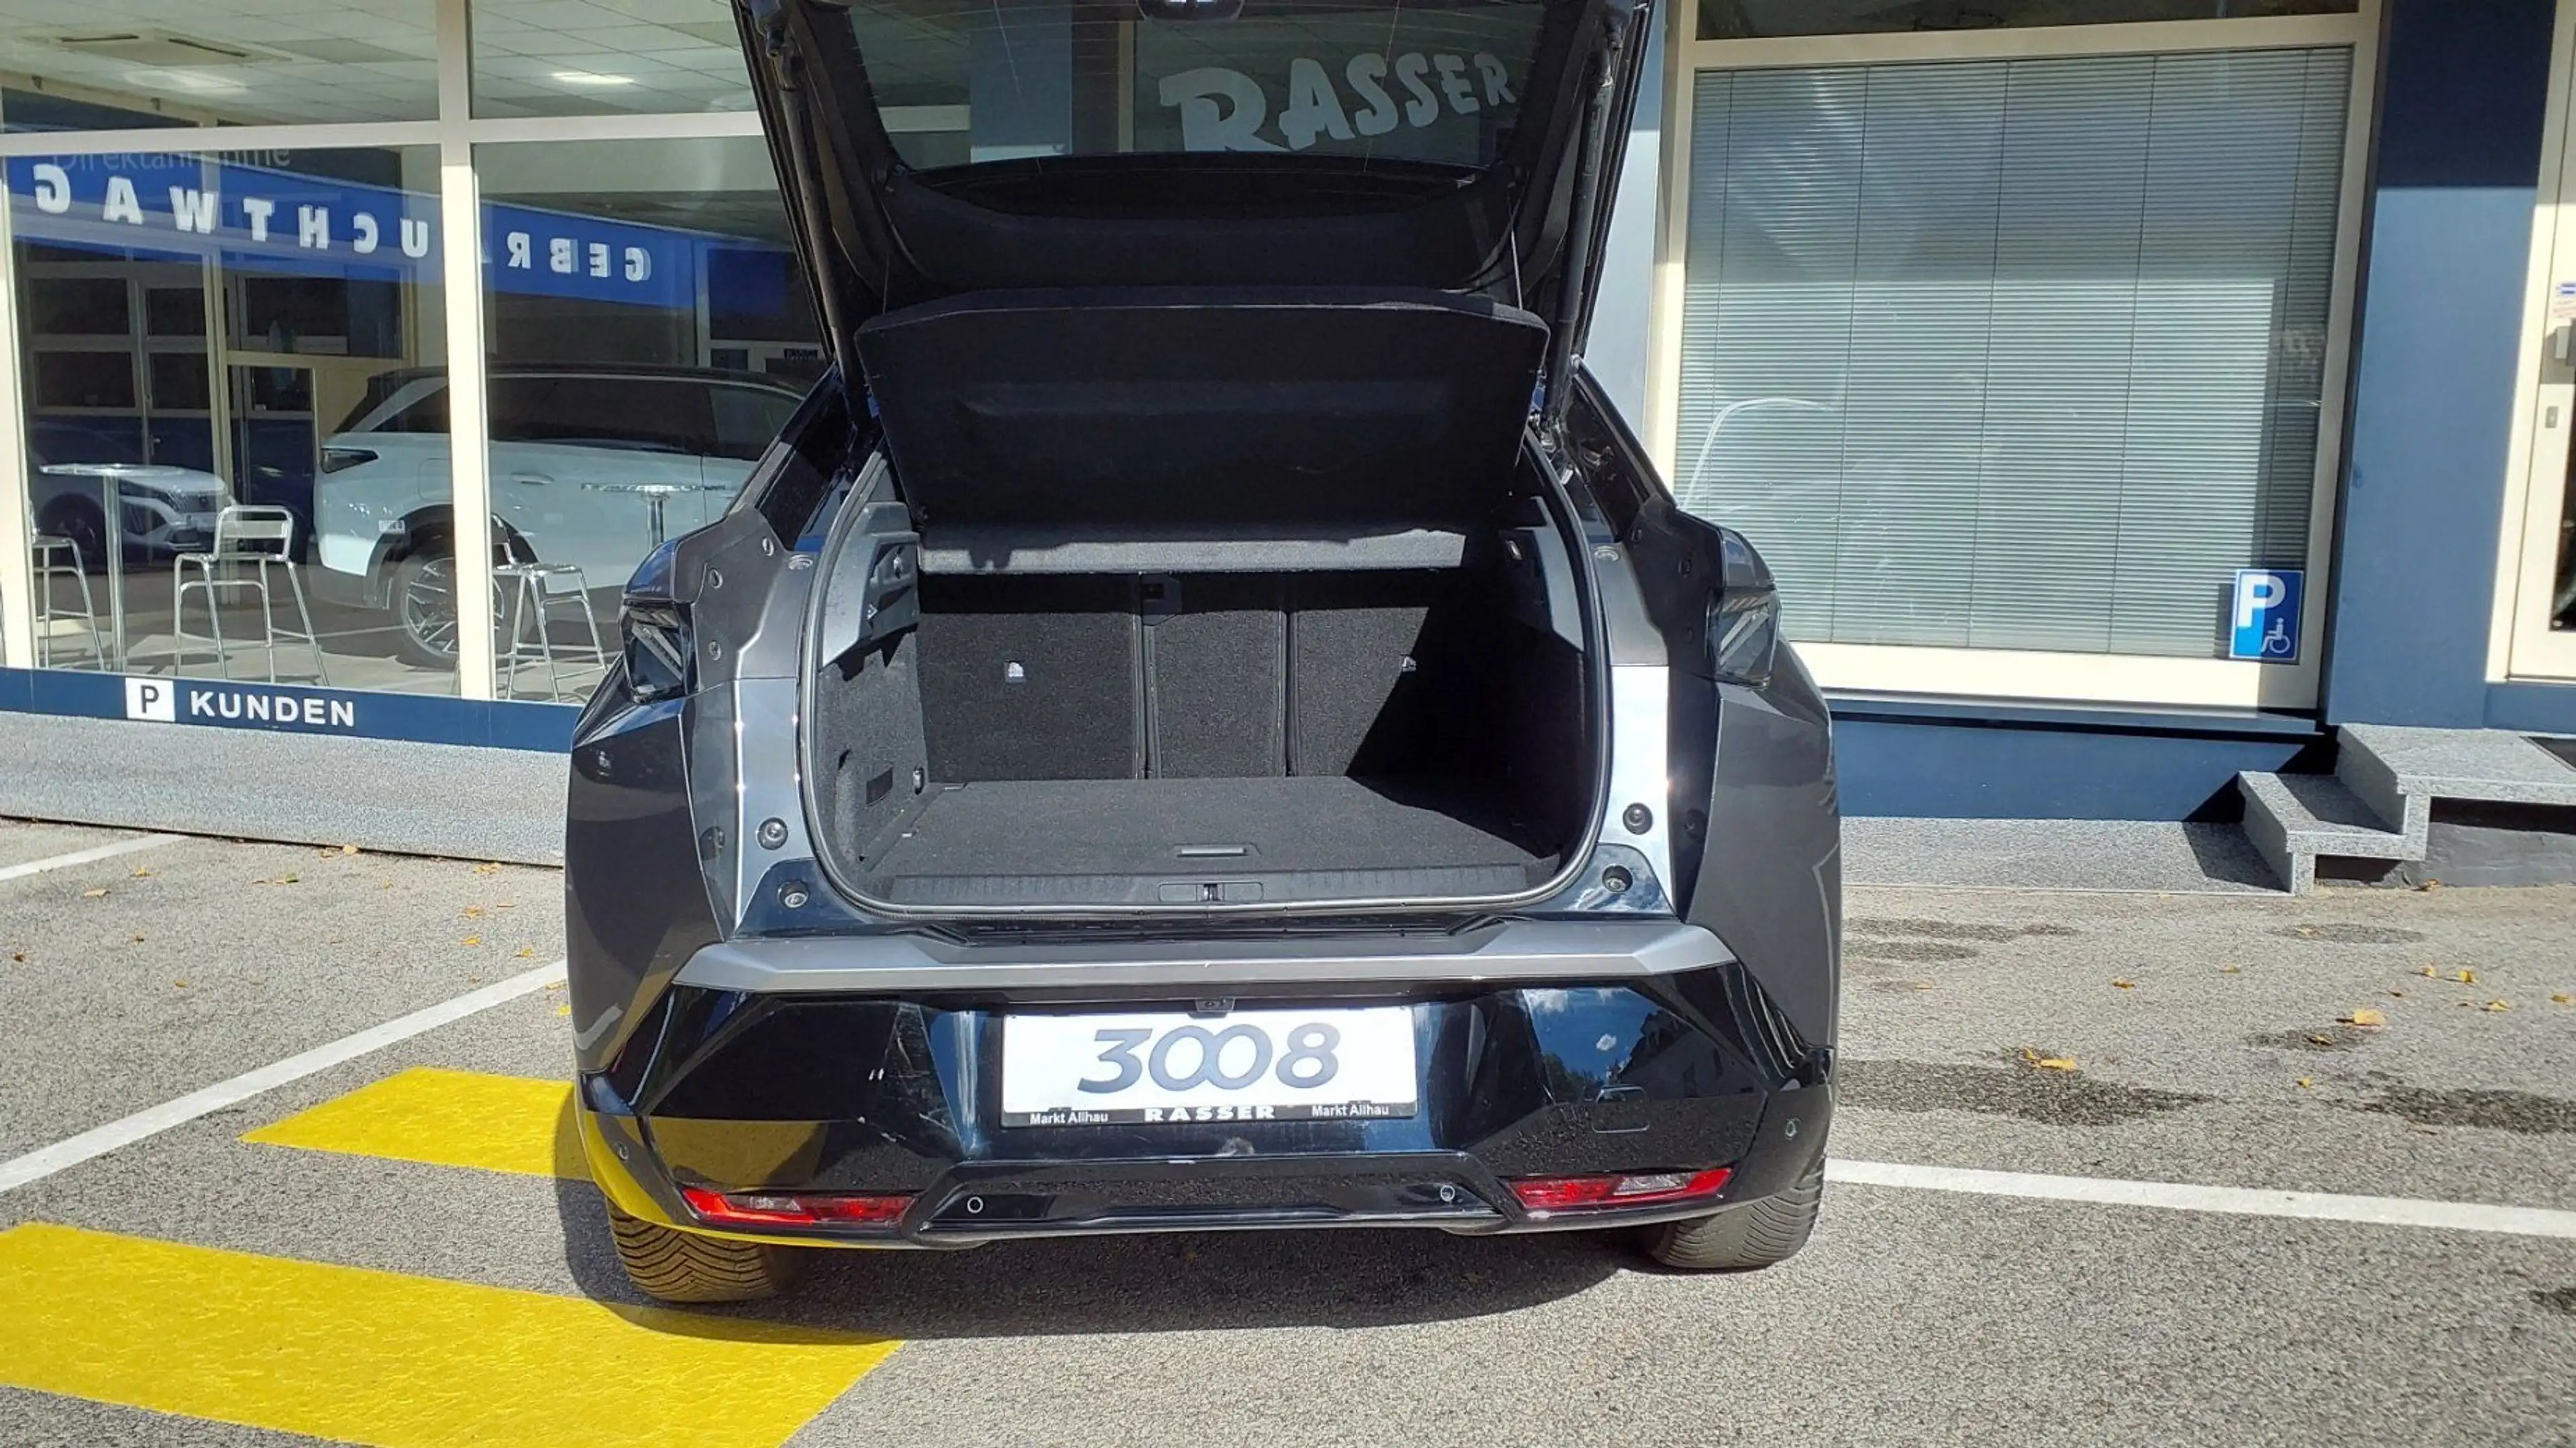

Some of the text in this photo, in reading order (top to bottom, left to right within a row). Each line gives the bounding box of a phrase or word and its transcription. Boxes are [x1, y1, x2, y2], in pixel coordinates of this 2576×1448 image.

[1159, 52, 1516, 154] RASSER
[2238, 573, 2286, 628] P
[142, 685, 355, 727] P KUNDEN
[1077, 1021, 1341, 1094] 3008
[1030, 1103, 1390, 1124] Markt Allhau RASSER Markt Allhau
